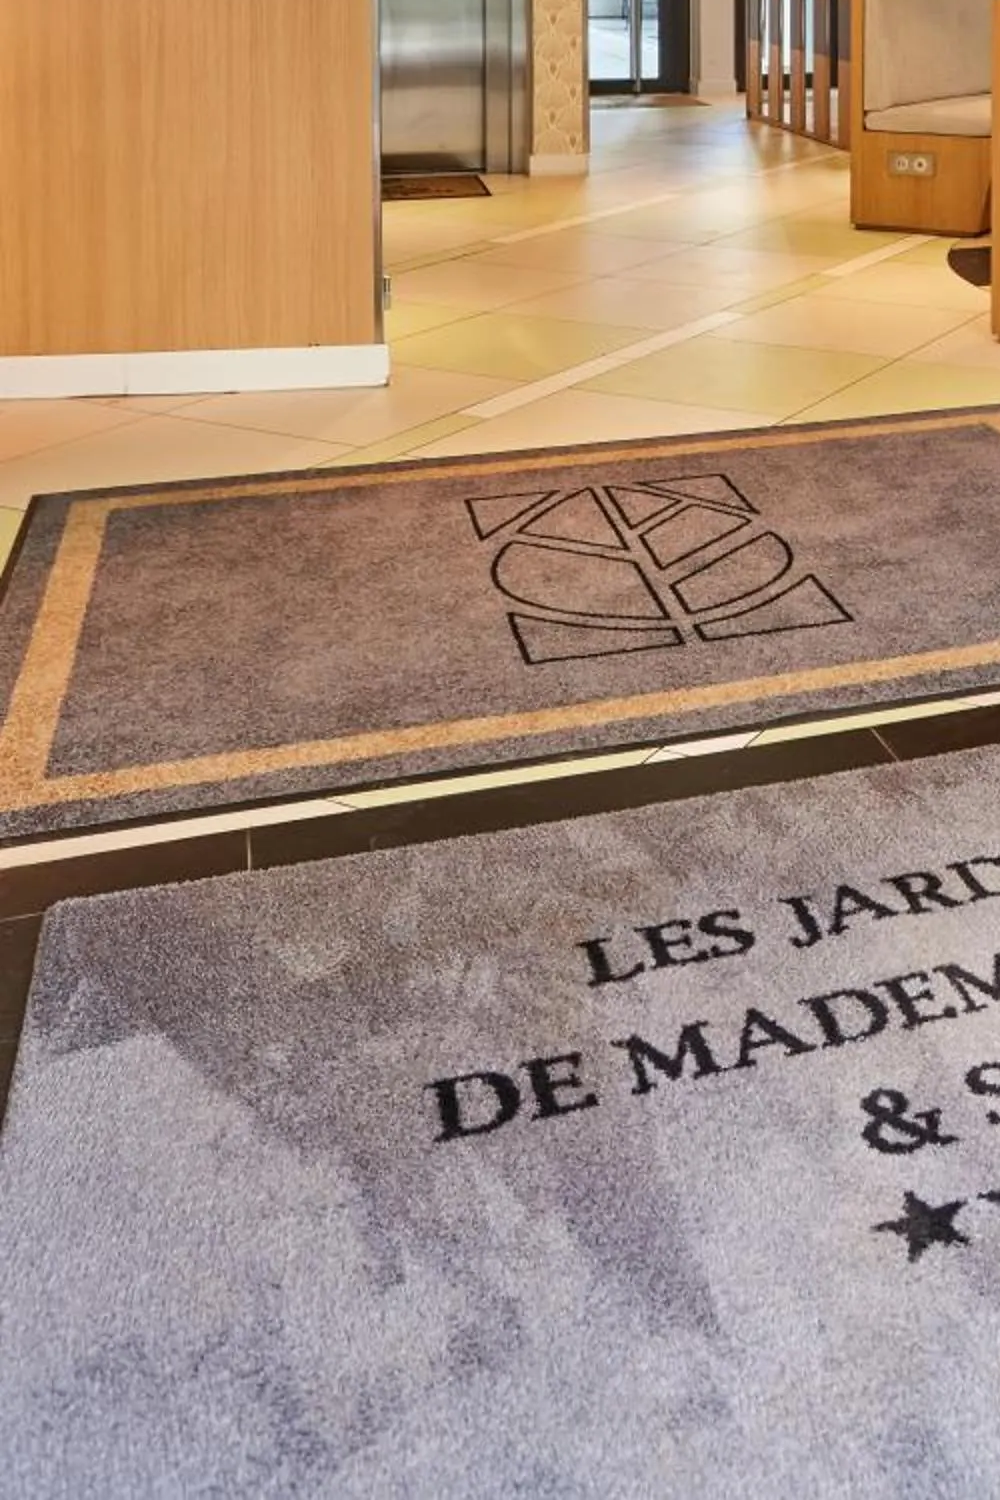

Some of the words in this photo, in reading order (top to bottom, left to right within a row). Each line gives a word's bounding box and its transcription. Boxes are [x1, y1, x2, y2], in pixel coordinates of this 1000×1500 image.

[575, 909, 756, 988] LES
[423, 1051, 599, 1143] DE
[860, 1088, 958, 1155] &
